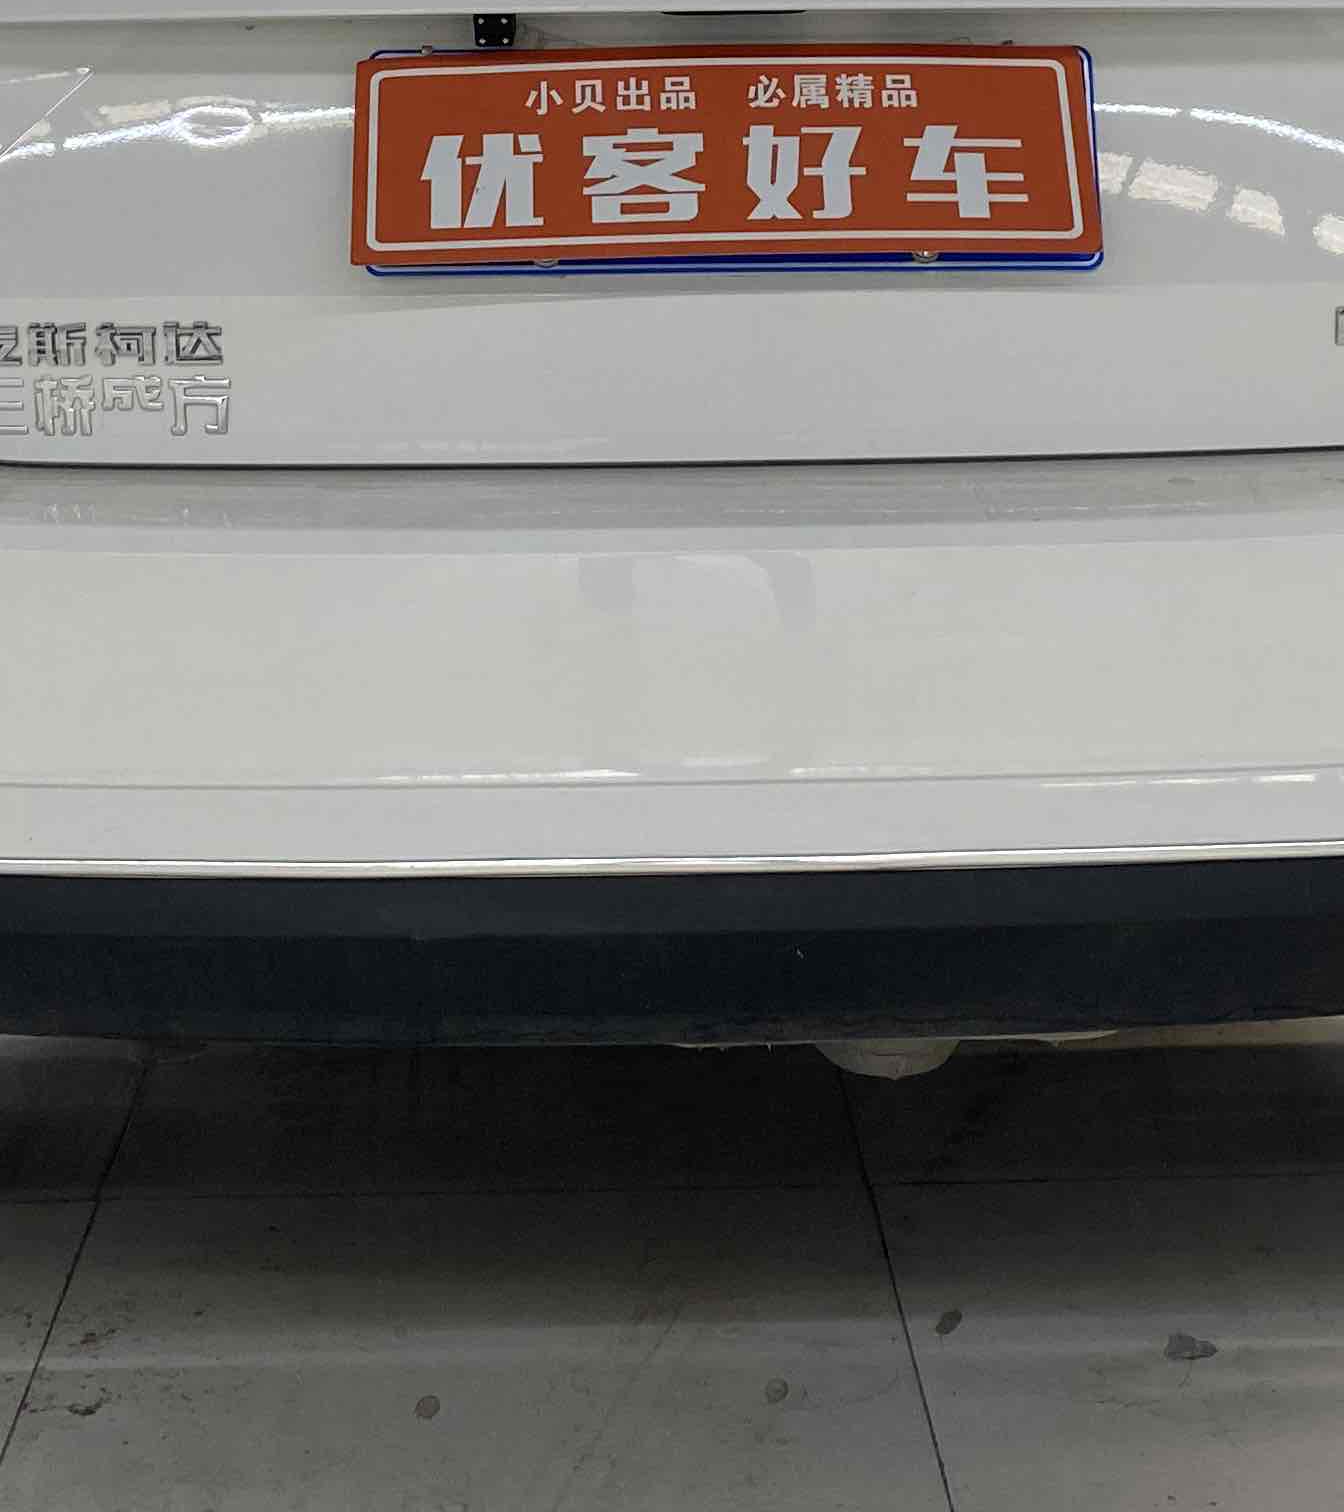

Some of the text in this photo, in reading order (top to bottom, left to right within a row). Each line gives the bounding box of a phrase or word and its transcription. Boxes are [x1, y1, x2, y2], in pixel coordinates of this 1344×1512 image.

[524, 72, 919, 114] 小贝出品 必属精品
[420, 124, 1031, 230] 优客好车
